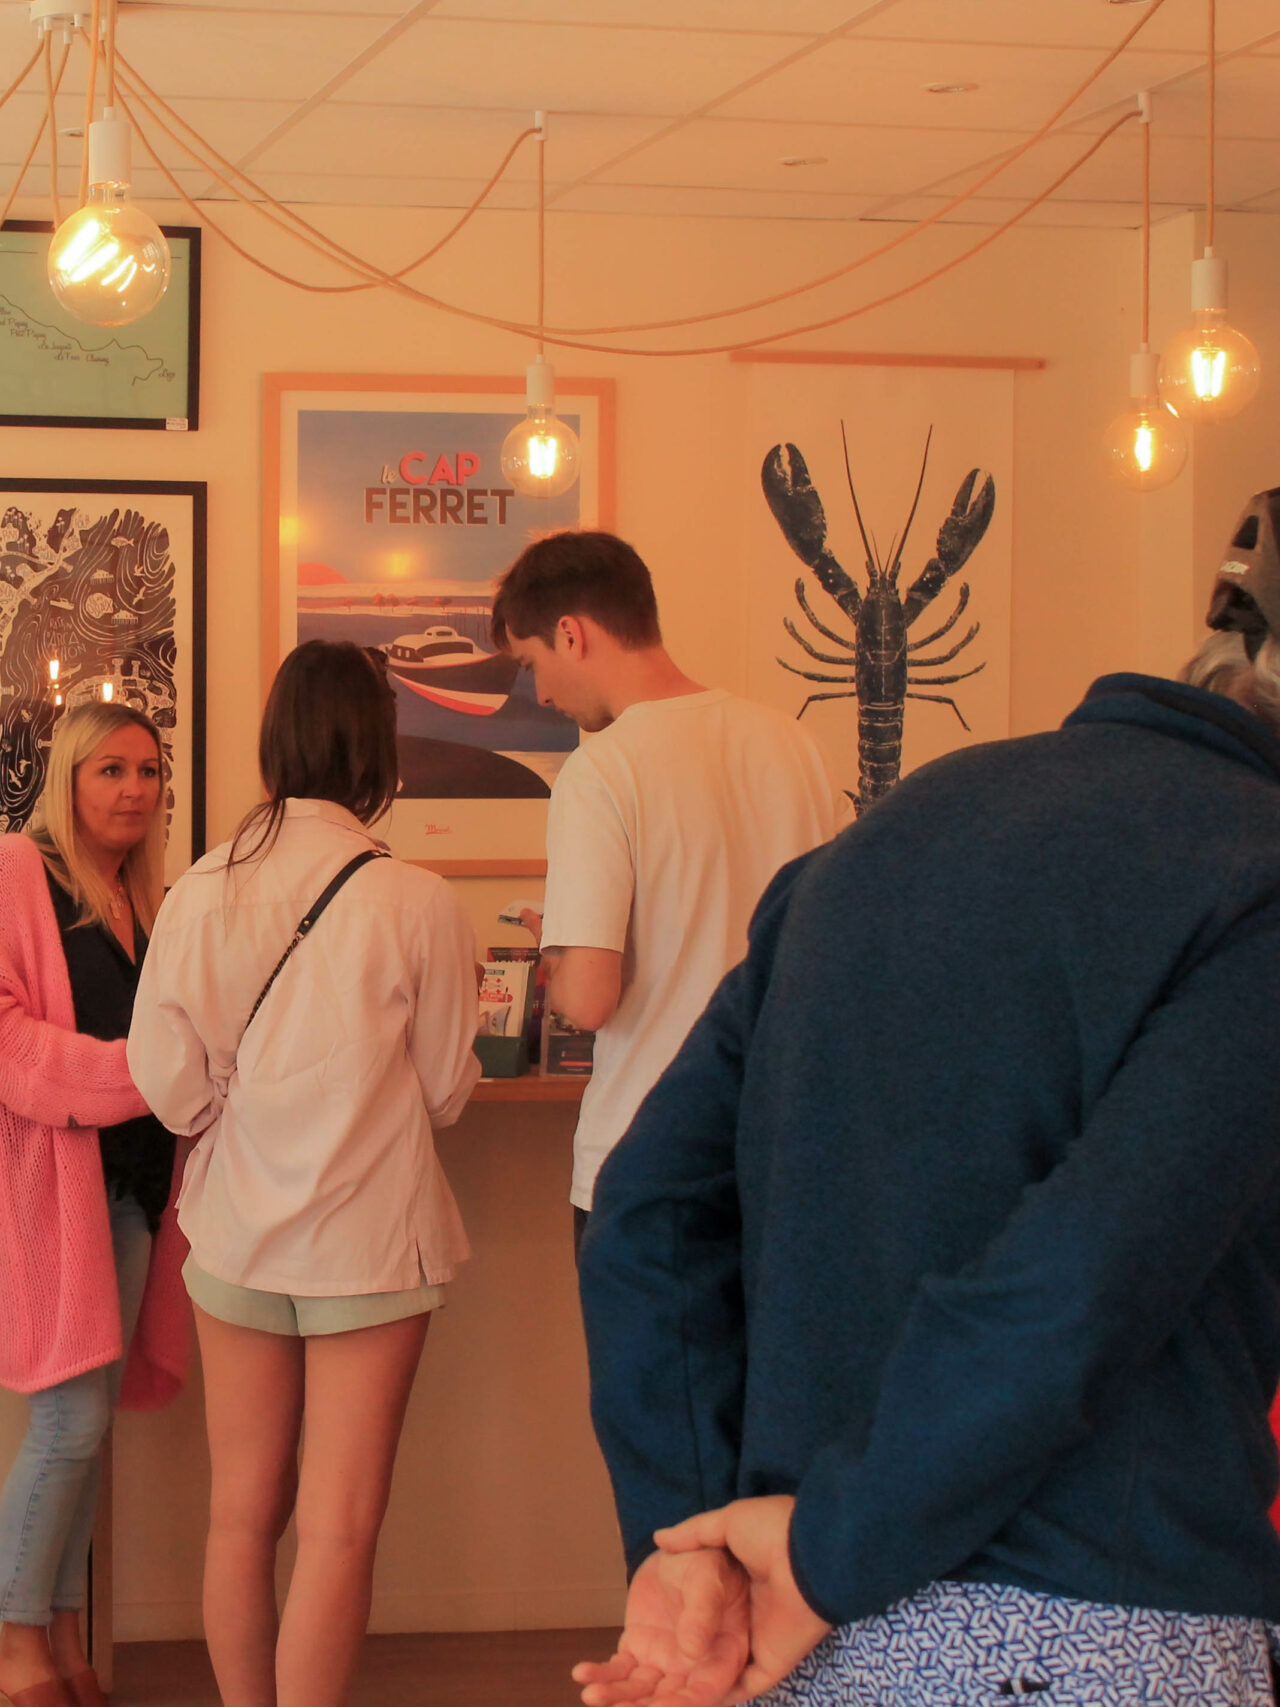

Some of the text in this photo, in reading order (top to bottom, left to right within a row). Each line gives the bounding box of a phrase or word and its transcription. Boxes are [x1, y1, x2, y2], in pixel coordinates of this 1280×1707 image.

[380, 451, 481, 486] le CAP
[365, 487, 515, 525] FERRET
